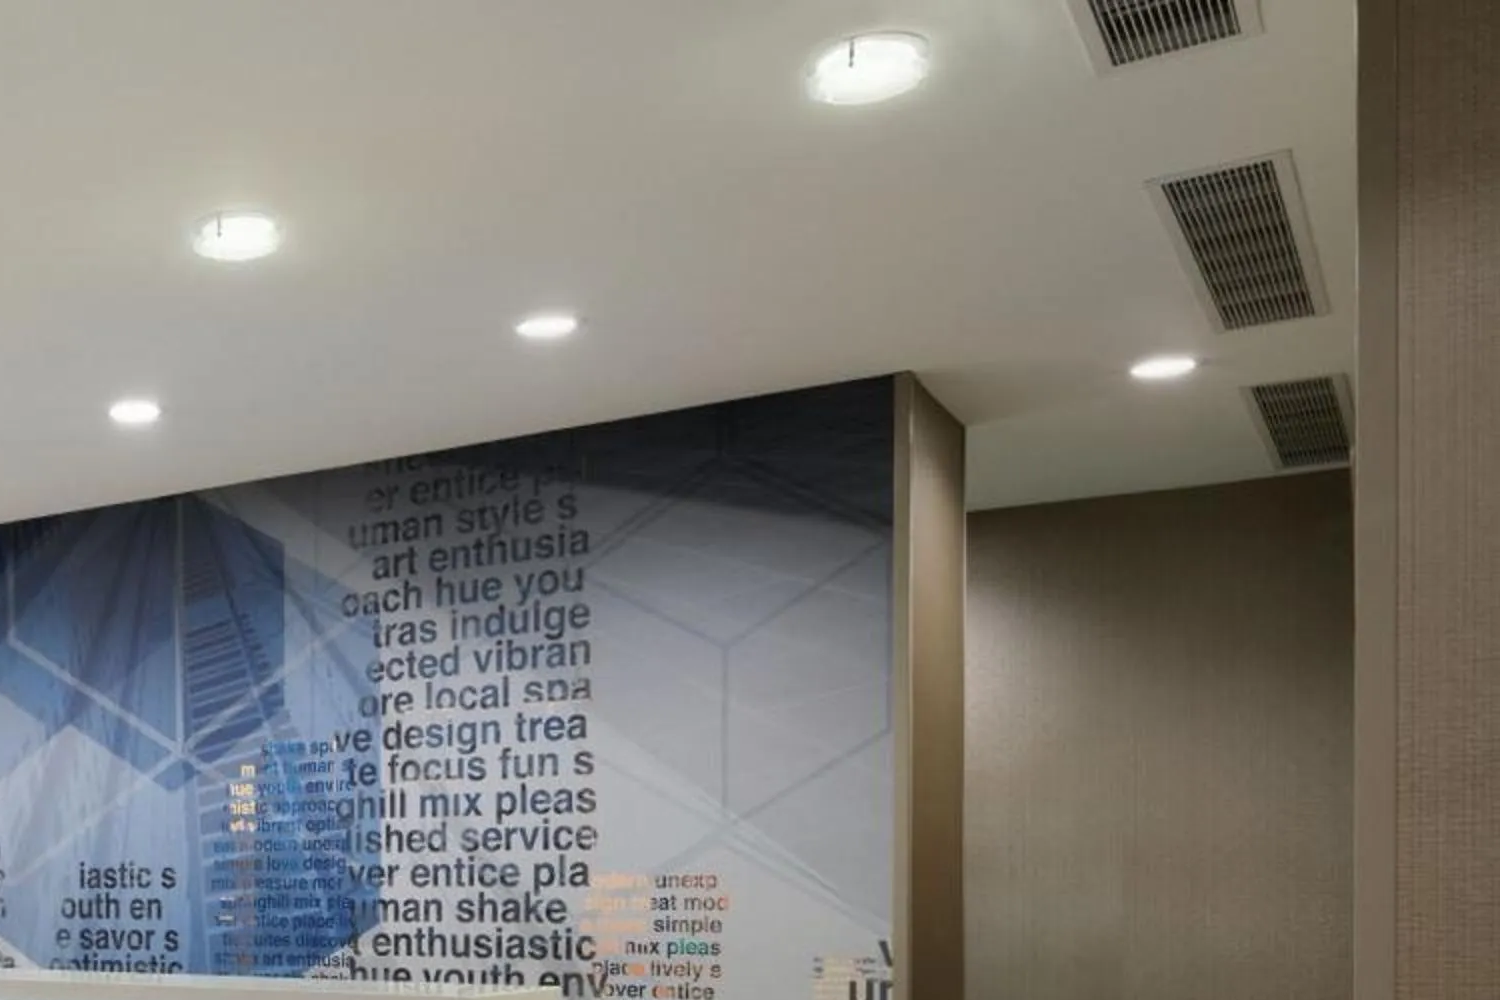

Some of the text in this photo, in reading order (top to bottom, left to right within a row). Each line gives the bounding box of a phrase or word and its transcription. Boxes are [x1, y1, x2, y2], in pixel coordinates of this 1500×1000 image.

[456, 494, 545, 536] style
[557, 492, 578, 521] s
[372, 528, 590, 580] art enthusia
[341, 566, 584, 618] oach hue you
[372, 599, 591, 648] tras indulge
[366, 638, 591, 684] ected vibran
[358, 676, 592, 718] ore local spa
[382, 719, 500, 754] design
[515, 711, 587, 743] trea
[388, 753, 487, 784] focus
[500, 747, 560, 780] fun
[573, 749, 595, 776] s
[419, 791, 483, 818] mix
[495, 783, 597, 824] pleas
[461, 818, 598, 852] service
[79, 861, 177, 890] iastic s
[410, 856, 521, 889] entice
[533, 854, 590, 896] pla
[654, 873, 718, 892] unexp
[61, 892, 163, 921] outh en
[455, 891, 568, 925] shake
[79, 927, 156, 951] savor
[163, 928, 179, 952] s
[653, 915, 723, 936] simple
[371, 926, 597, 962] enthusiastic
[666, 939, 722, 960] pleas
[650, 960, 704, 983] lively
[651, 983, 715, 1000] entice
